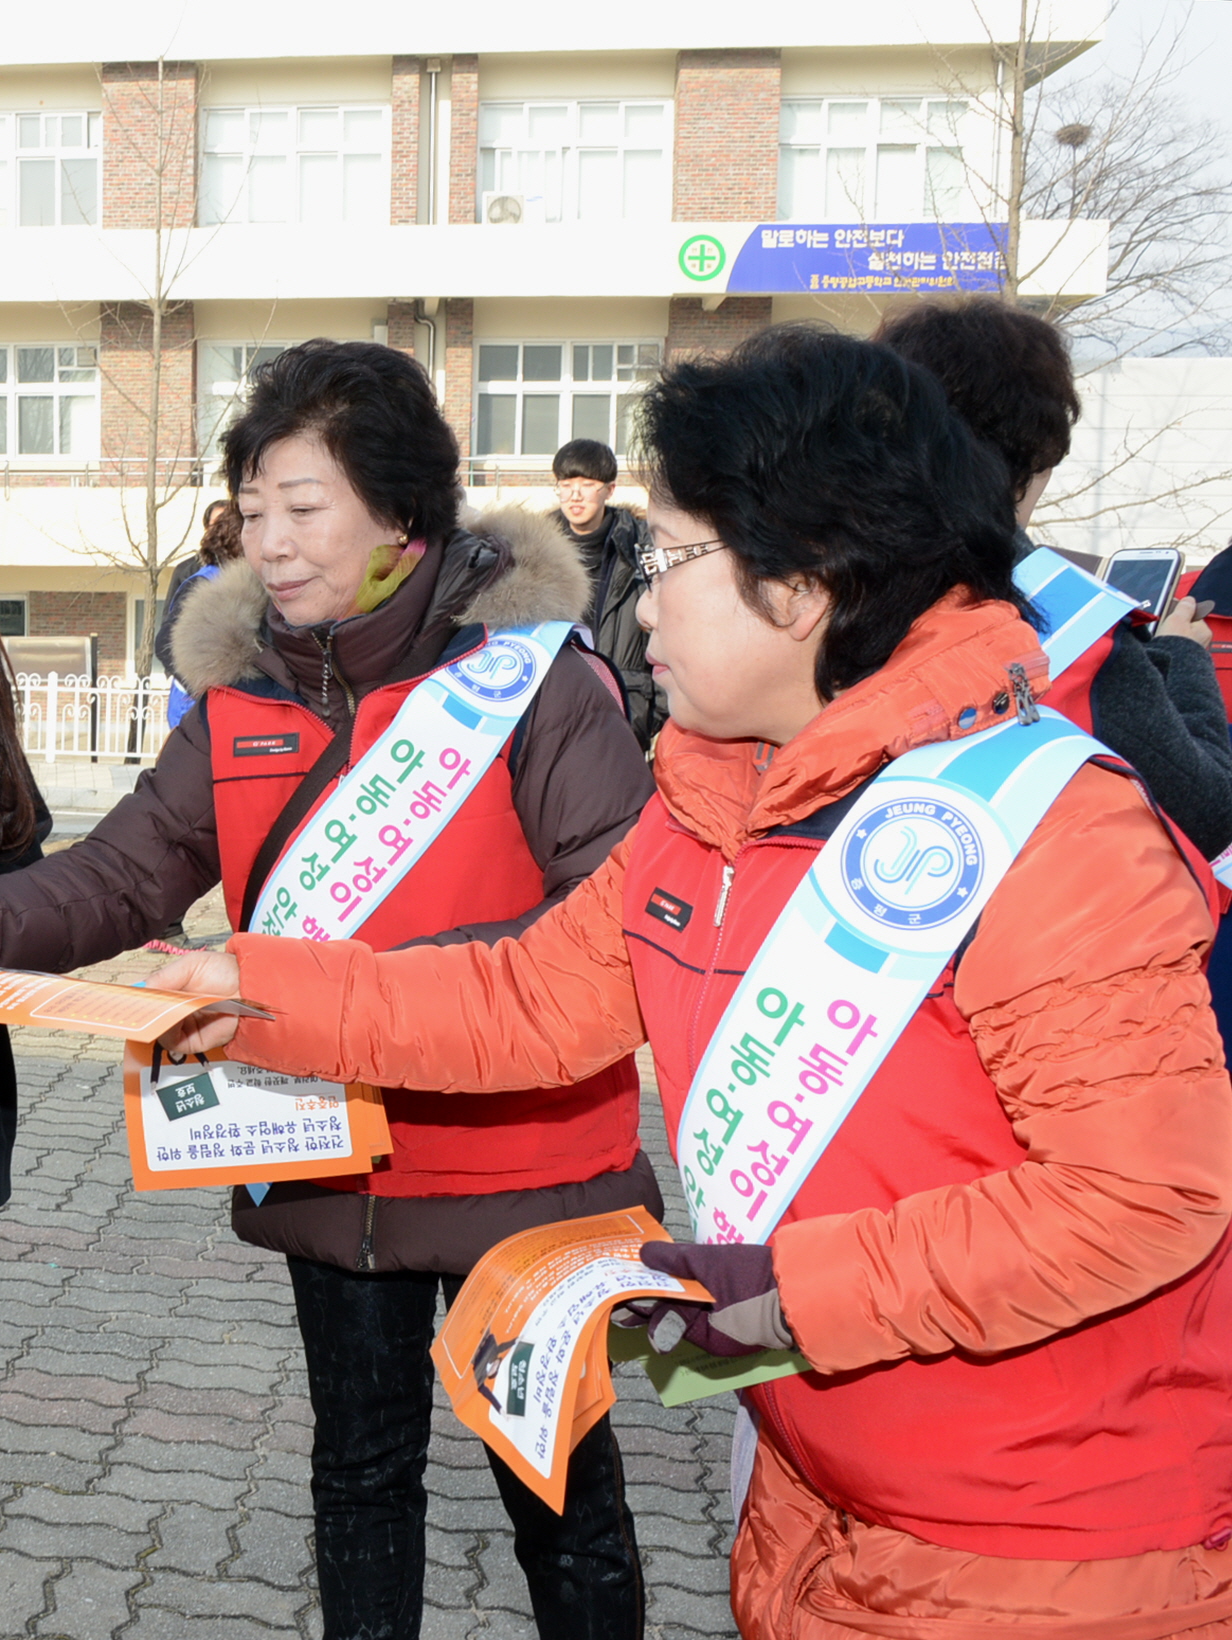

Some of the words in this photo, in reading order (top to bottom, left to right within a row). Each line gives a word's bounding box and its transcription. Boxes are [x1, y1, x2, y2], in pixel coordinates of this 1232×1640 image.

[761, 228, 829, 248] 말로하는
[834, 228, 905, 248] 안전보다
[868, 251, 936, 271] 실천하는
[885, 803, 936, 819] JEUNG
[941, 812, 978, 866] PYEONG
[175, 1082, 196, 1098] 보호
[175, 1093, 205, 1113] 청소년
[295, 1095, 339, 1111] 연중추진
[189, 1123, 241, 1141] 환경정비
[245, 1120, 297, 1135] 유해업소
[302, 1115, 342, 1133] 청소년
[186, 1142, 225, 1160] 정립을
[230, 1141, 256, 1157] 문화
[260, 1137, 300, 1154] 청소년
[304, 1134, 344, 1151] 건전한
[156, 1146, 182, 1161] 위한
